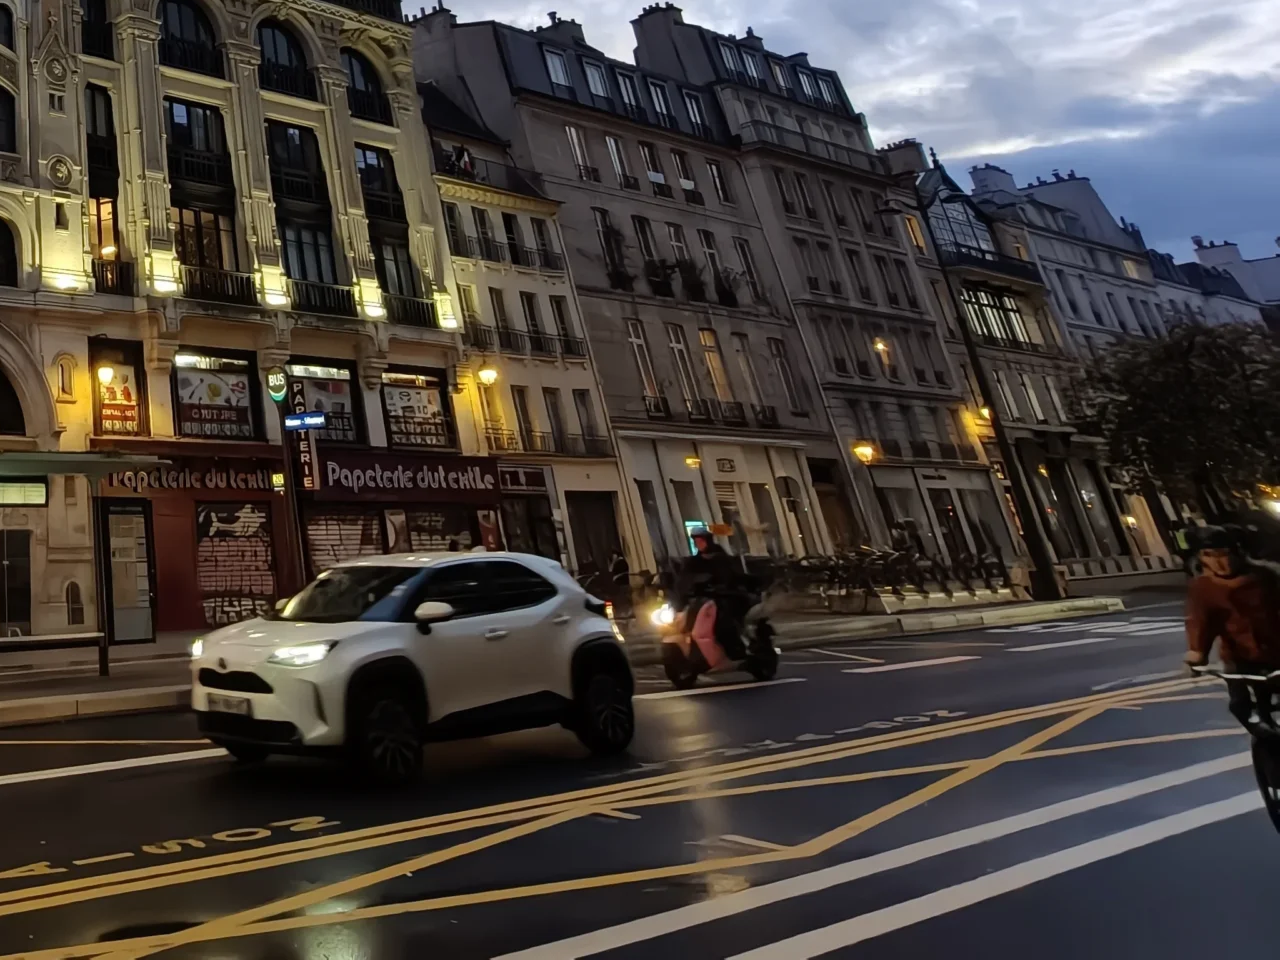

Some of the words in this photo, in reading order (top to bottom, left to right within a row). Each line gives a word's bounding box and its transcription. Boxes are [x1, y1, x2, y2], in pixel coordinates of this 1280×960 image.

[268, 373, 285, 386] BUS
[293, 383, 313, 488] PAPTERIE
[205, 468, 227, 489] du
[326, 461, 414, 494] Papeterie
